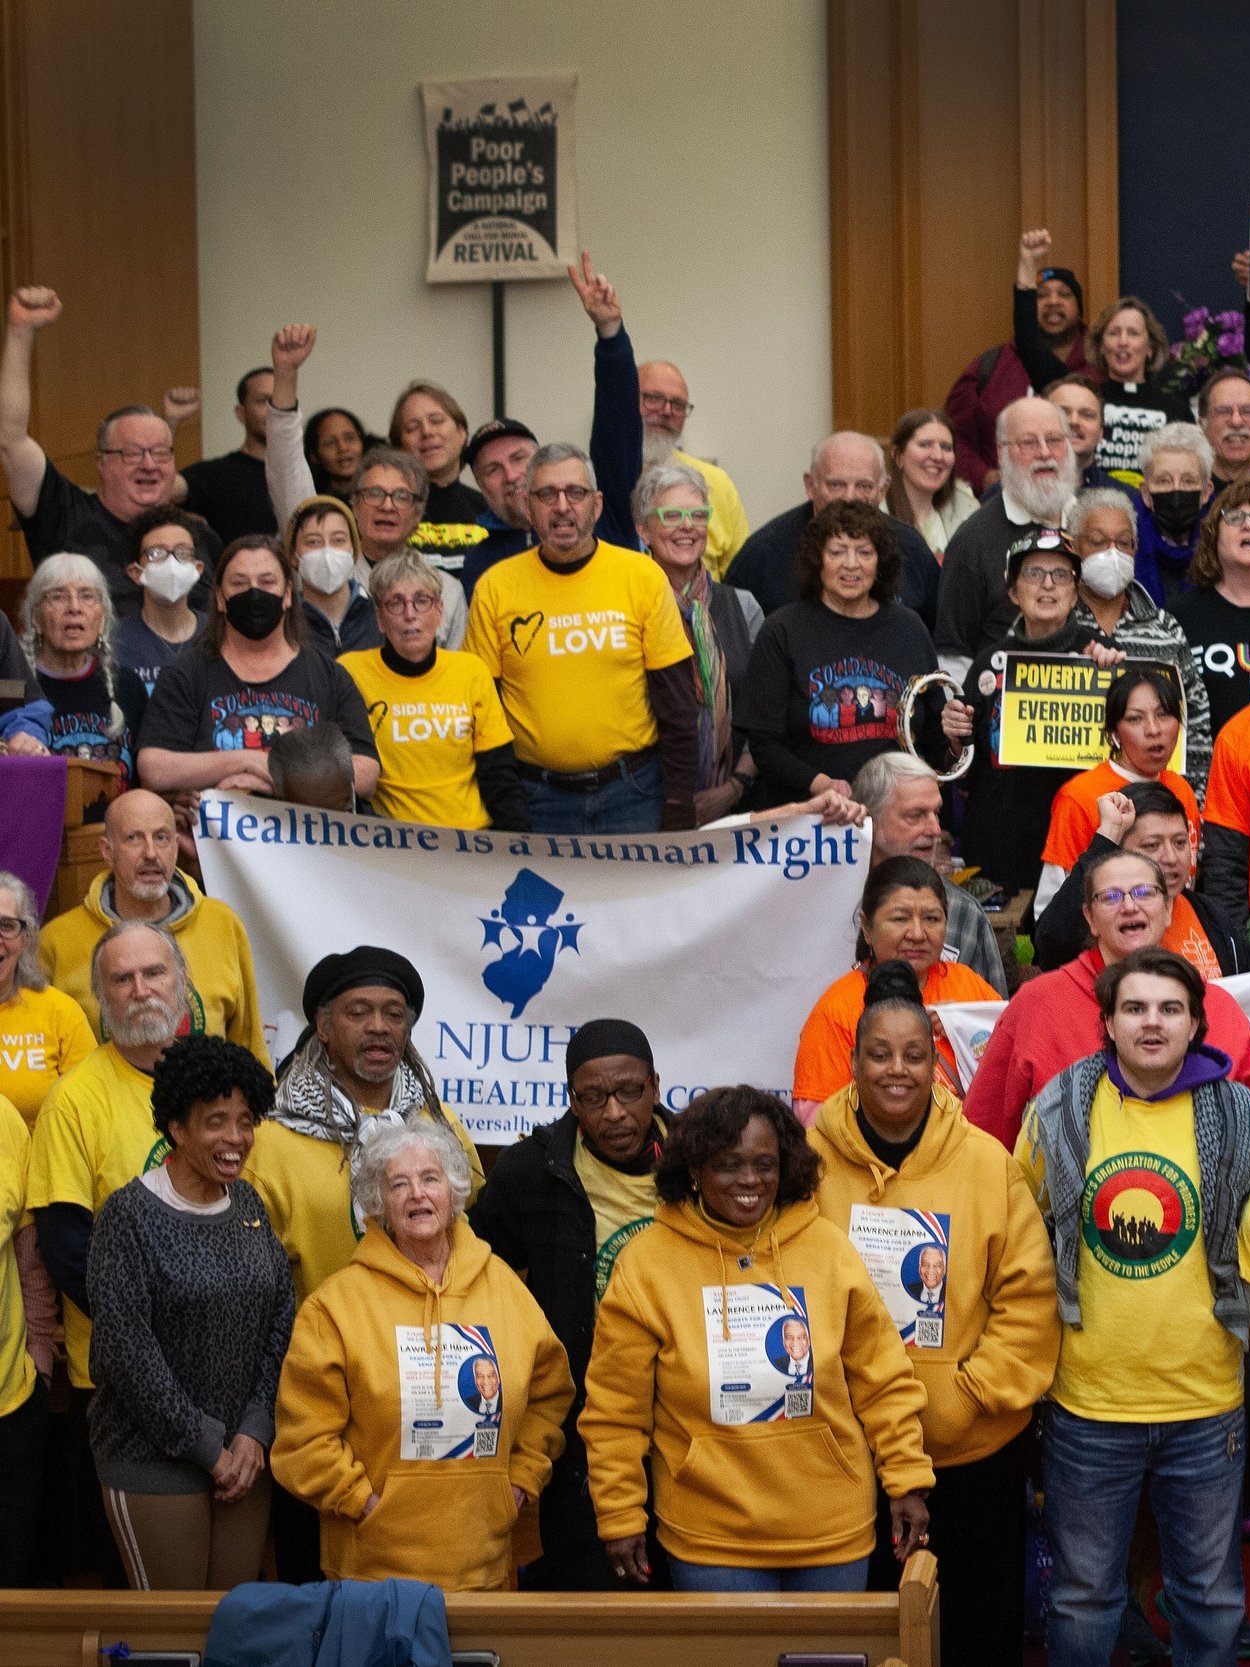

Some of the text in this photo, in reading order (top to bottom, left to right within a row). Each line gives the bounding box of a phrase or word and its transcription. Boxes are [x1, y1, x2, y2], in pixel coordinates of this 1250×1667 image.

[471, 137, 525, 162] Poor
[452, 161, 545, 190] People's
[448, 189, 548, 215] Campaign
[454, 242, 539, 262] REVIVAL
[548, 609, 626, 629] SIDE WITH
[549, 625, 628, 657] LOVE
[1015, 662, 1094, 691] POVERTY
[391, 702, 427, 717] SIDE
[1018, 700, 1106, 723] EVERYBOD
[391, 715, 472, 743] LOVE
[1026, 725, 1092, 746] A RIGHT
[198, 799, 859, 881] Healthcare Is a Human Right
[2, 1032, 45, 1046] WITH
[435, 1020, 578, 1071] NJUH
[442, 1078, 569, 1108] HEALTH
[1094, 1155, 1161, 1183] ORGANIZATION
[1162, 1164, 1179, 1183] FOR
[1175, 1179, 1196, 1231] PROGRESS
[851, 1223, 927, 1239] LAWRENCE HAMM
[1094, 1244, 1181, 1278] POWER TO THE PEOPLE
[757, 1303, 787, 1314] HAMM
